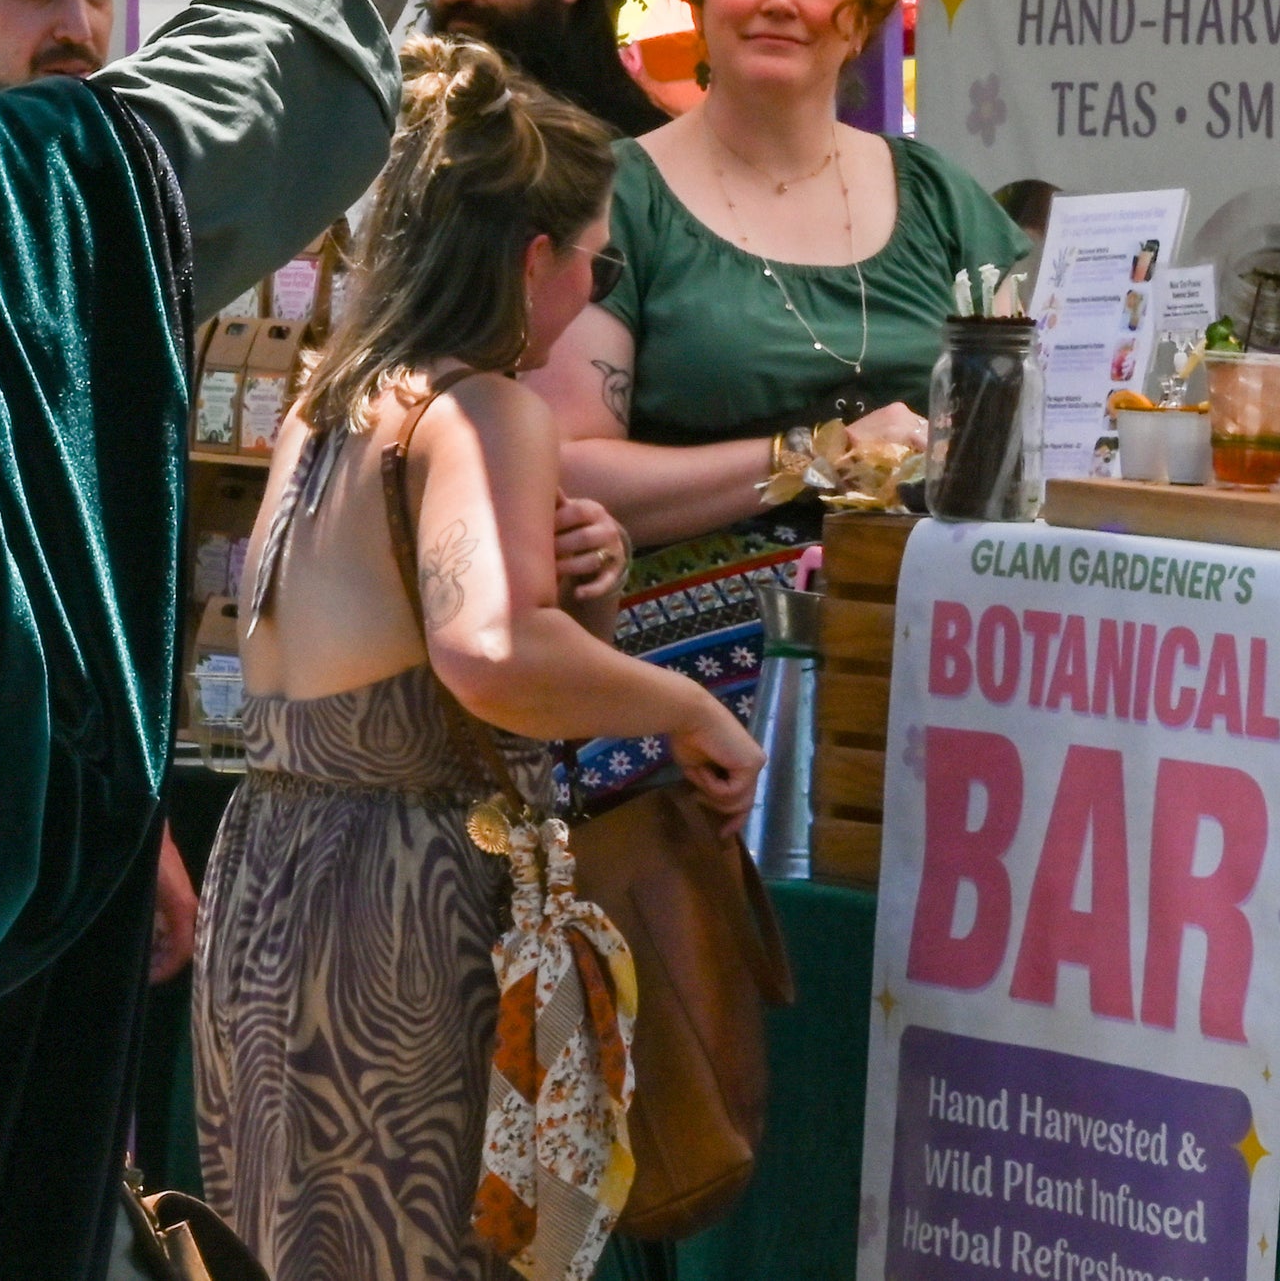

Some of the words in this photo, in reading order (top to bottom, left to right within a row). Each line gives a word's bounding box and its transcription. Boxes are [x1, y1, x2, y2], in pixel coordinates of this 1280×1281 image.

[1050, 80, 1158, 139] TEAS
[970, 539, 1061, 583] GLAM
[1068, 547, 1256, 605] GARDENER'S
[906, 724, 1268, 1047] BAR
[928, 1076, 1009, 1132] Hand
[1020, 1092, 1168, 1168] Harvested
[1178, 1131, 1208, 1173] &
[924, 1143, 993, 1199] Wild
[1003, 1160, 1084, 1217] Plant
[1091, 1177, 1208, 1245] Infused
[903, 1207, 1001, 1270] Herbal
[1011, 1231, 1210, 1281] Refresh
